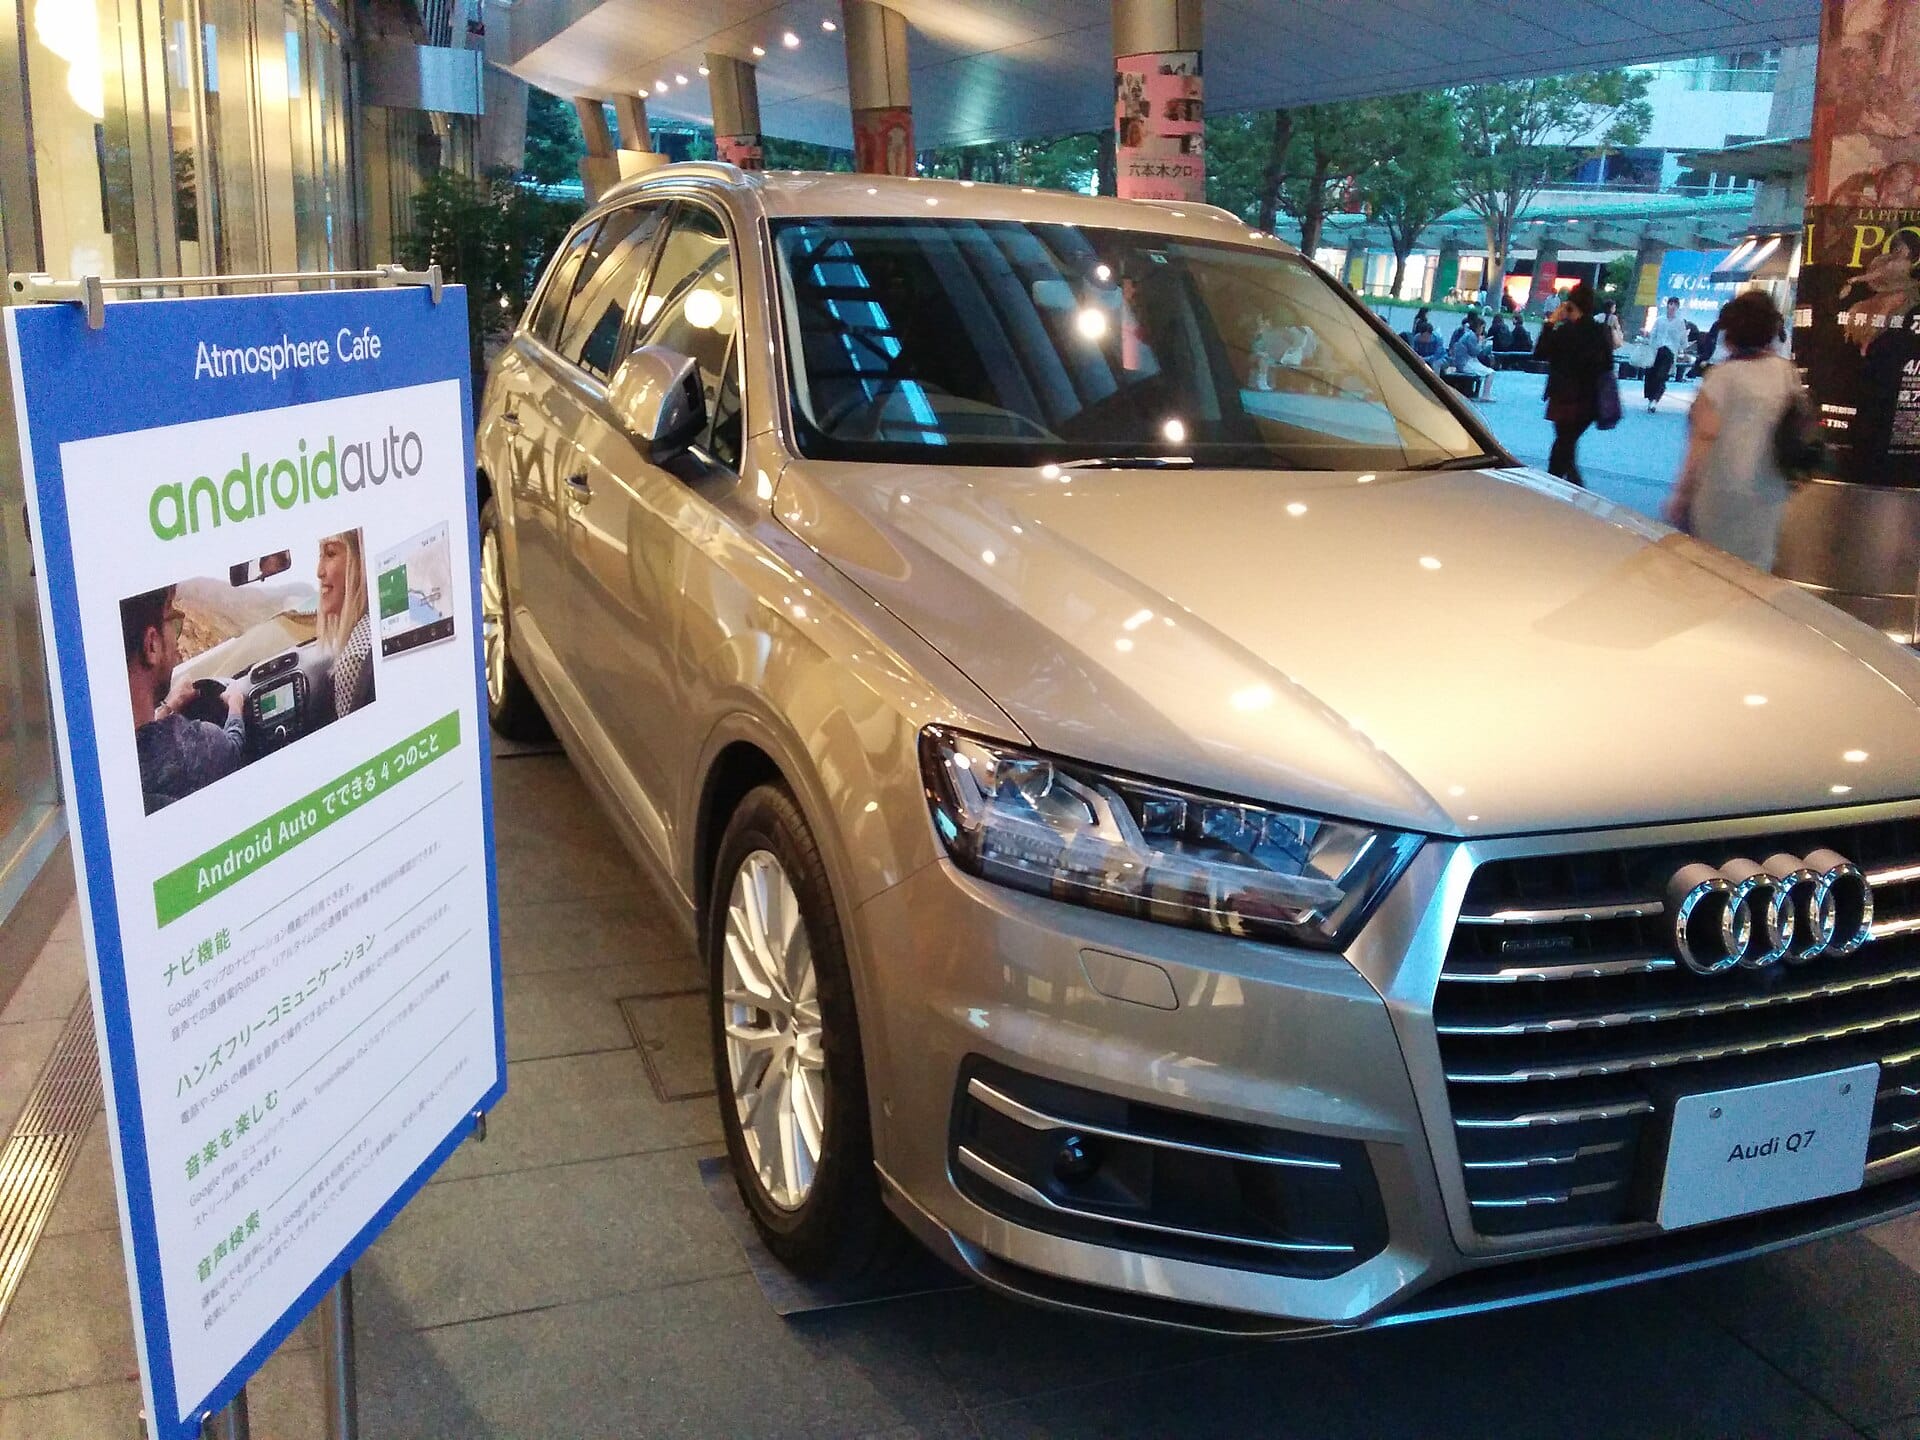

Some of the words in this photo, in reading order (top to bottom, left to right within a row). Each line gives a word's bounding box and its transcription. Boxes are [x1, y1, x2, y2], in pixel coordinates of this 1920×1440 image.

[195, 334, 329, 380] Atmosphere
[337, 326, 381, 363] Cafe
[1827, 418, 1849, 429] TBS
[196, 828, 273, 894] Android
[277, 803, 318, 846] Auto
[163, 927, 232, 988] ナビ機能
[176, 932, 376, 1098] ハンズフリーコミュニケーション
[185, 1088, 278, 1181] 音楽を楽しむ
[1727, 1136, 1780, 1162] Audi
[1785, 1129, 1816, 1153] Q7
[197, 1209, 260, 1282] 音声検索
